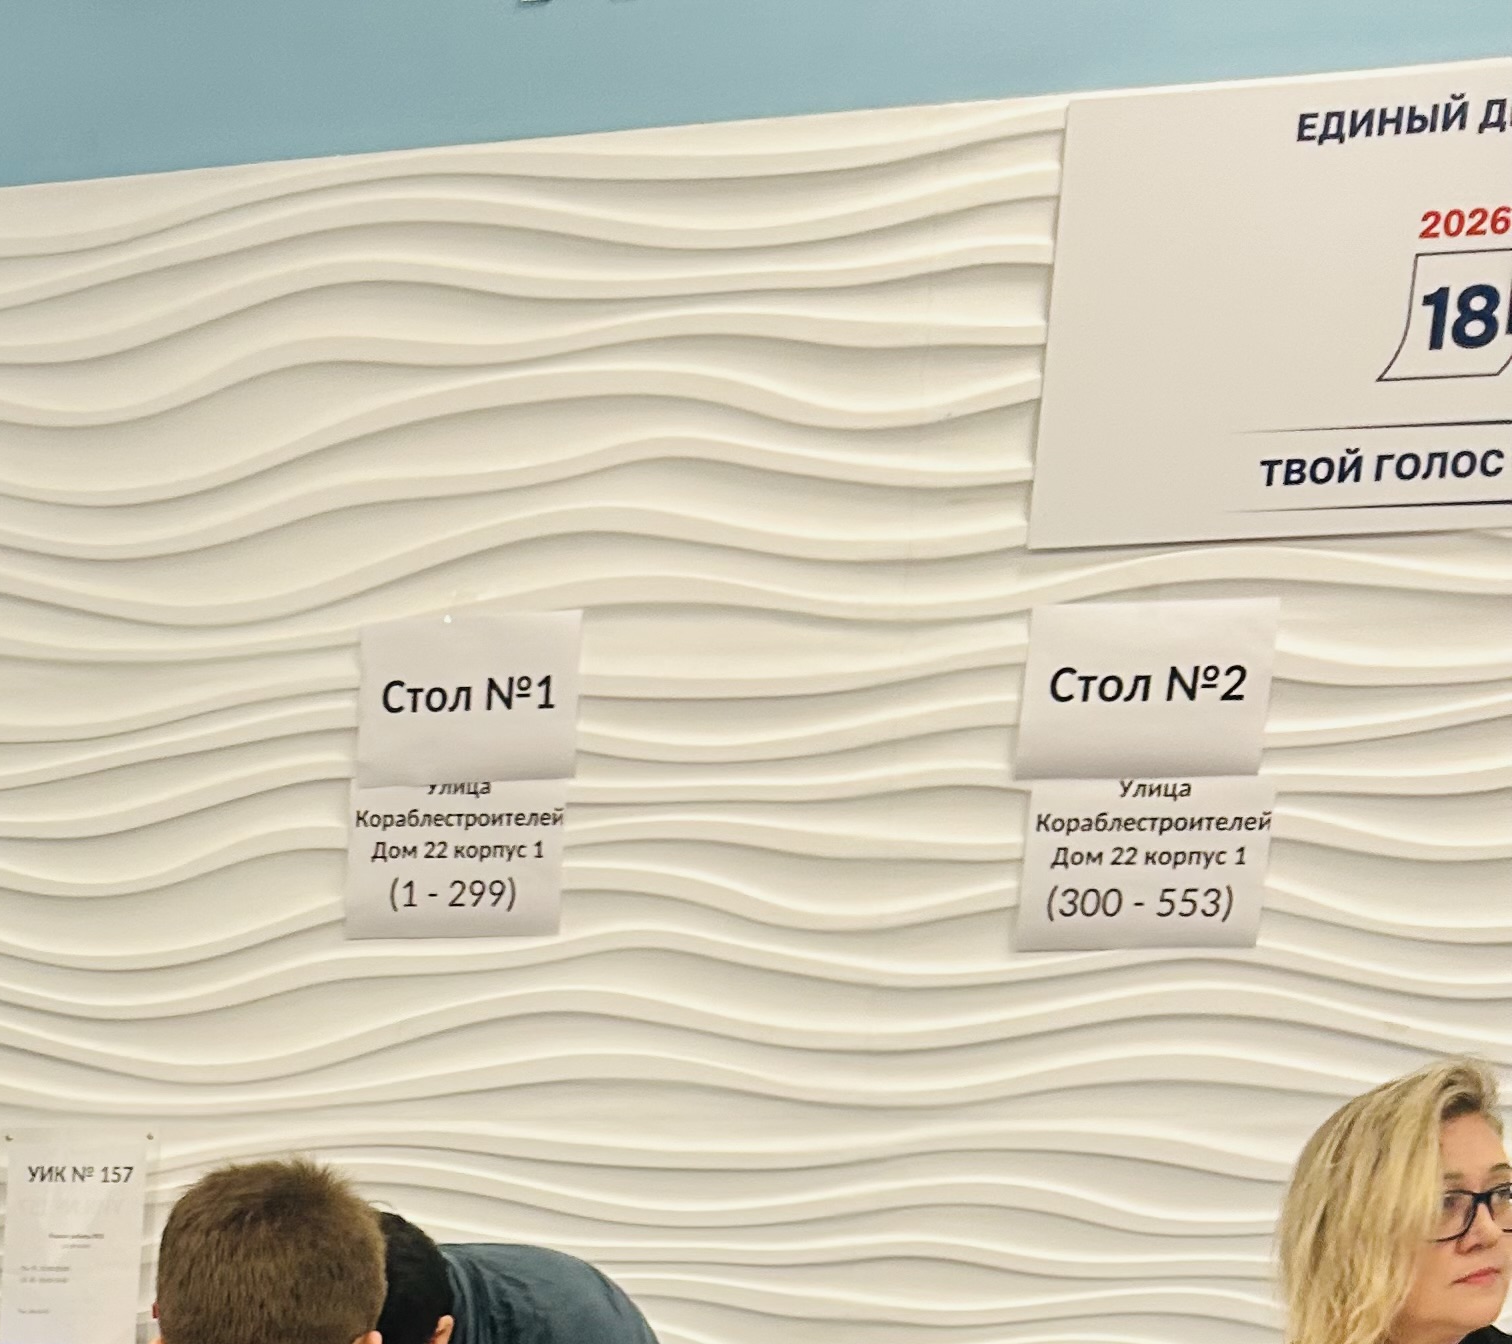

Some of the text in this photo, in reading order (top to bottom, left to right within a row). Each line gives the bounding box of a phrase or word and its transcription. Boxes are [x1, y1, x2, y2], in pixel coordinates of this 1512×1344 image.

[1296, 92, 1512, 145] ЕДИНЫЙ Д
[1419, 205, 1512, 239] 2026
[1421, 284, 1500, 351] 18
[1260, 448, 1504, 487] ТВОЙ ГОЛОС
[381, 674, 555, 714] Стол №1
[1049, 664, 1248, 703] Стол №2
[1118, 779, 1192, 801] Улица
[355, 807, 565, 831] Кораблестроителей
[1035, 811, 1273, 836] Кораблестроителей
[371, 840, 543, 863] Дом 22 корпус 1
[1050, 846, 1246, 870] Дом 22 корпус 1
[389, 877, 418, 912] (1
[448, 877, 516, 912] 299)
[1046, 885, 1123, 922] (300
[1156, 885, 1235, 922] 553)
[27, 1165, 135, 1183] УИК № 157
